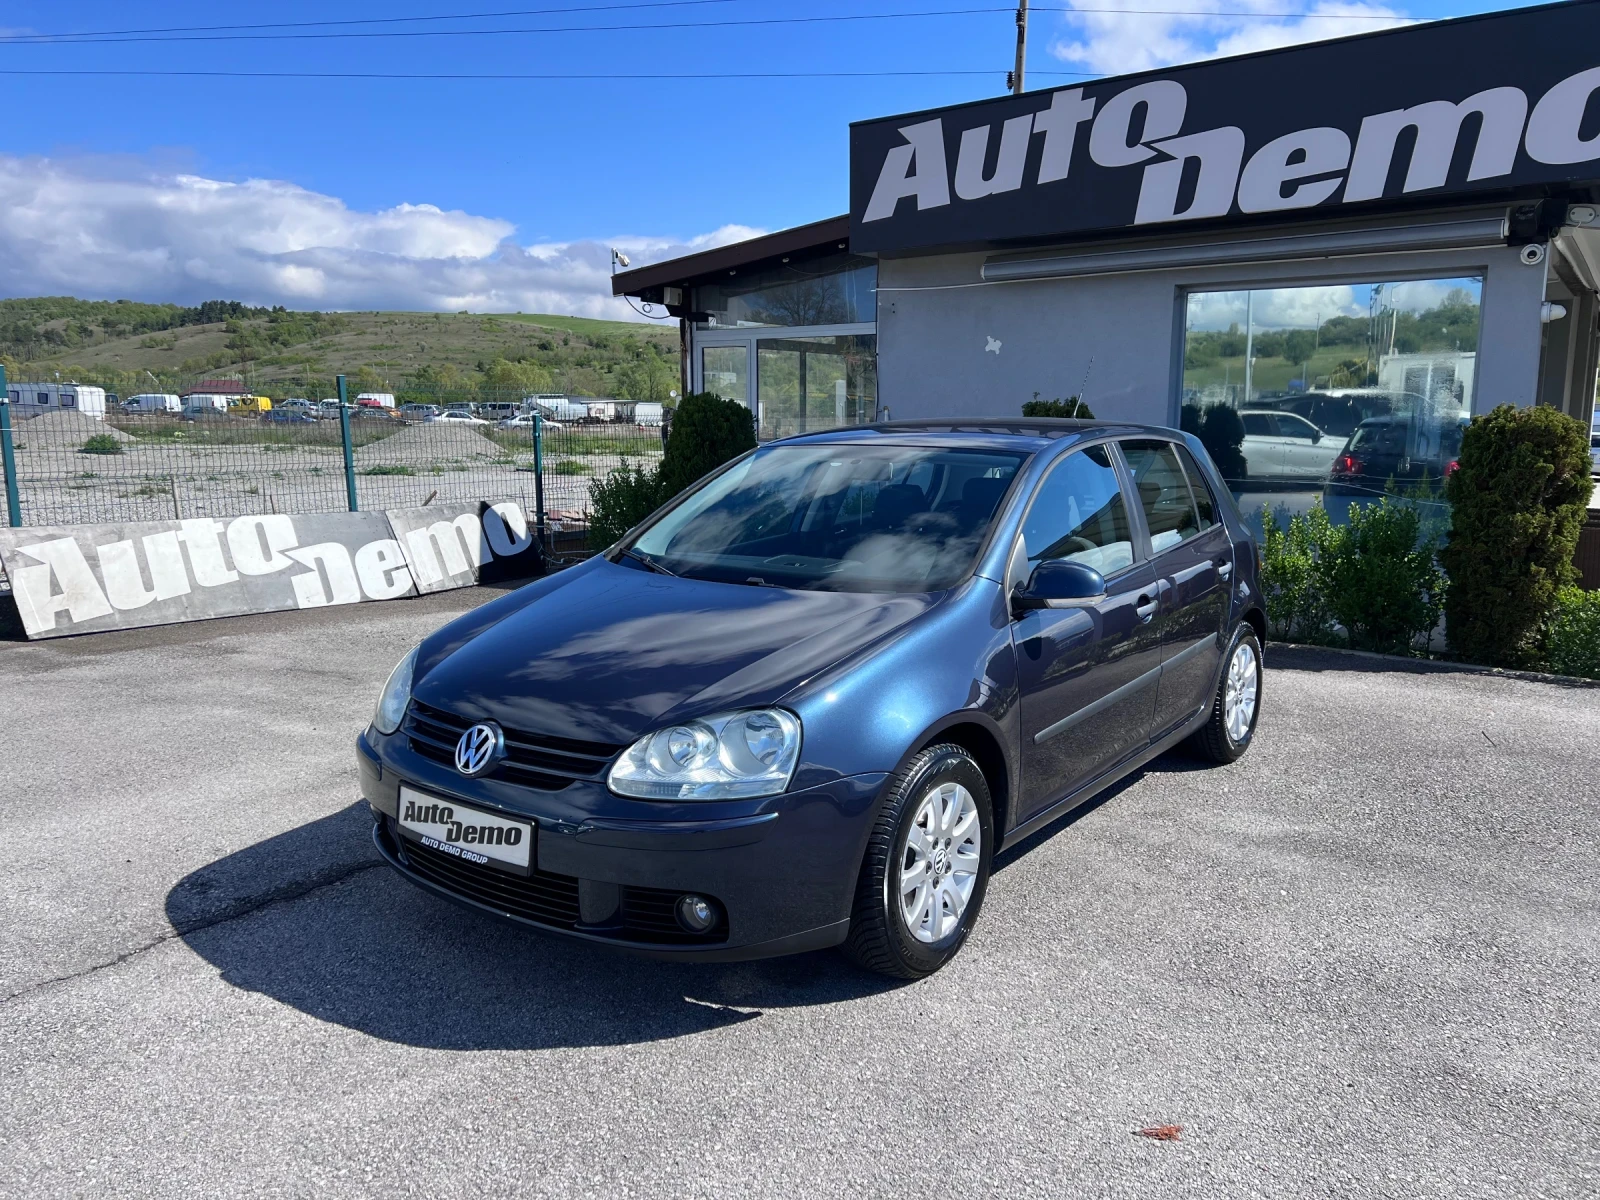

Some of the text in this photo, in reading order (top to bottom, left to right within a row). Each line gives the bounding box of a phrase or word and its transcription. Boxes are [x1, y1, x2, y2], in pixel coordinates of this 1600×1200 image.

[862, 79, 1188, 223] Auto
[13, 502, 533, 640] Auto Demo
[404, 801, 522, 846] Auto Demo
[420, 836, 488, 864] AUTO DEMO GROUP
